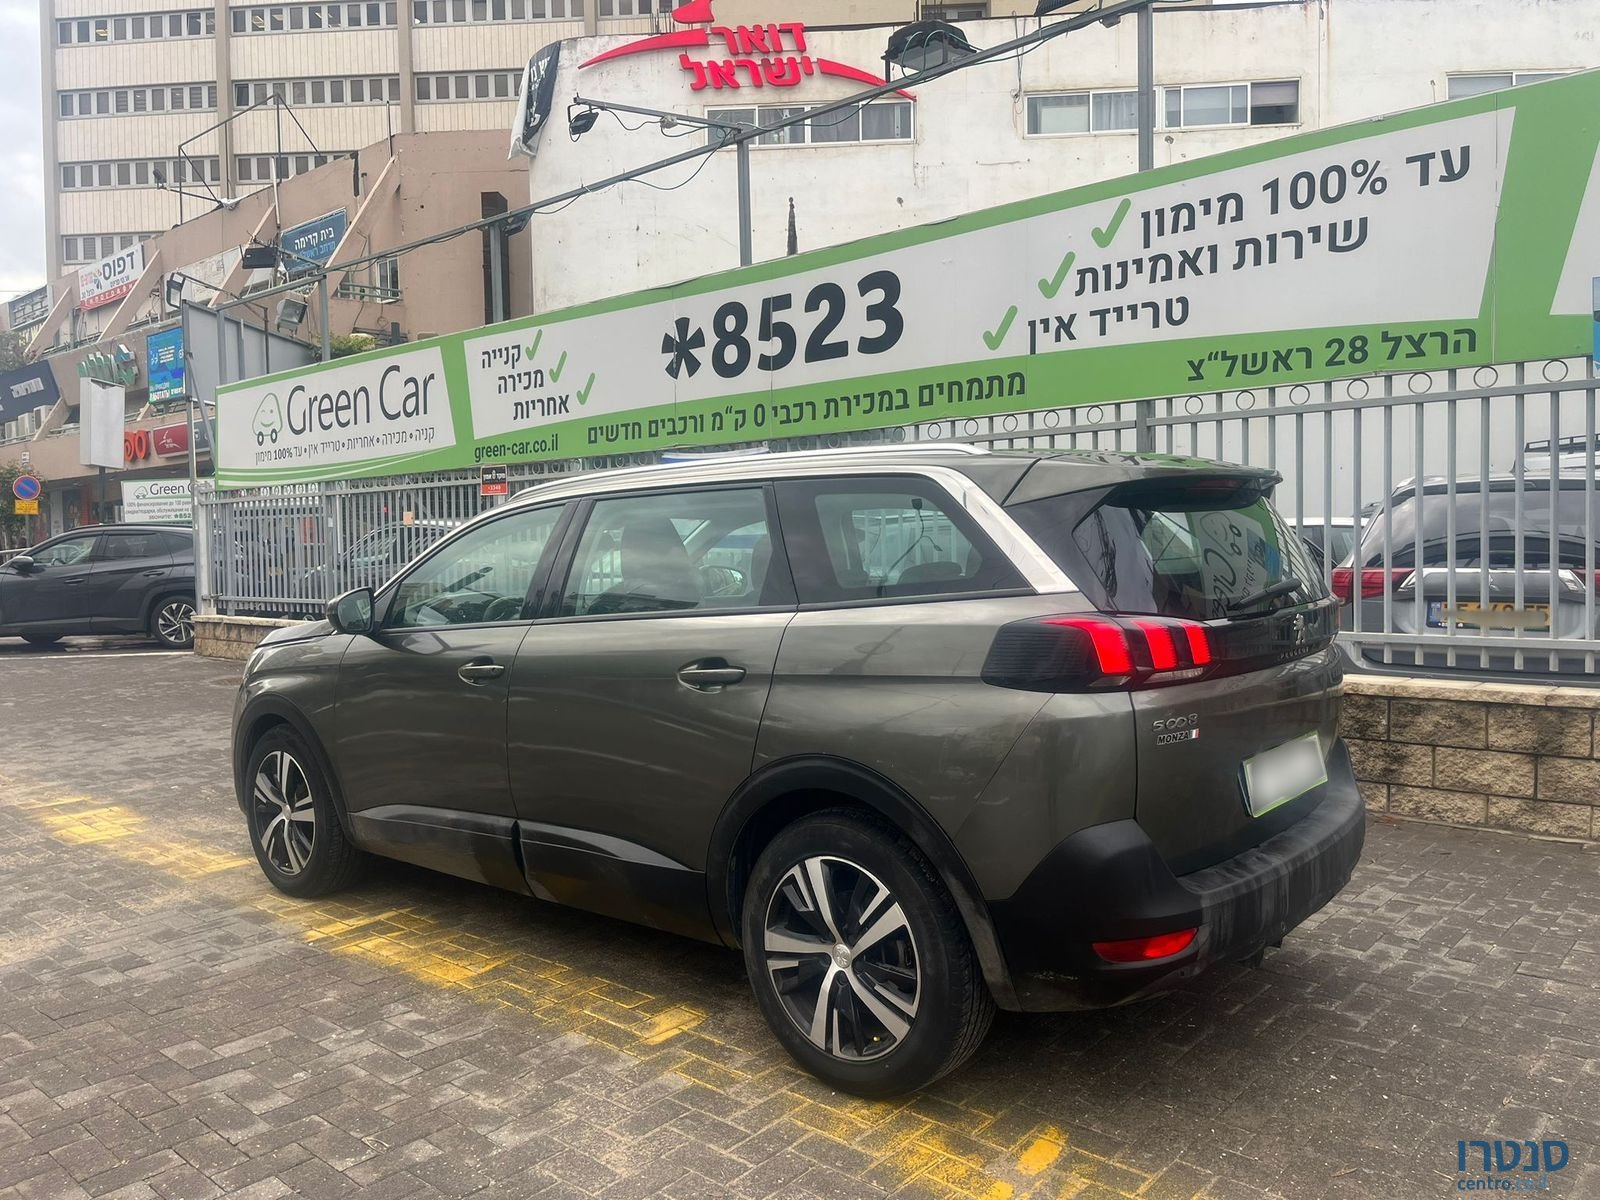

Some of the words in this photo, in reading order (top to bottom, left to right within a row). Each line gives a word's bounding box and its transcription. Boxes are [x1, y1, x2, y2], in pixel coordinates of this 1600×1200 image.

[710, 22, 807, 55] דואר
[679, 54, 814, 90] ישראל
[1406, 145, 1471, 187] עד
[1262, 159, 1387, 215] 100%
[1141, 192, 1243, 248] מימון
[294, 232, 318, 251] קדימה
[320, 227, 334, 241] בית
[1233, 216, 1369, 271] שירות
[102, 251, 135, 281] דפוס
[1075, 245, 1218, 297] ואמינות
[1089, 295, 1189, 337] טרייד
[1027, 313, 1077, 355] אין
[1381, 327, 1476, 361] הרצל
[482, 344, 521, 369] קנייה
[1325, 335, 1368, 368] 28
[498, 369, 544, 394] מכירה
[918, 371, 1026, 406] מתמחים
[287, 385, 370, 436] Green
[379, 365, 435, 421] Car
[513, 394, 570, 420] אחריות
[772, 399, 817, 425] רכבי
[824, 391, 909, 419] במכירת
[648, 415, 705, 438] ורכבים
[753, 403, 766, 427] 0
[320, 439, 340, 453] טרייד
[346, 435, 375, 450] אחריות
[382, 430, 407, 446] מכירה
[415, 427, 435, 445] קניה
[587, 422, 642, 445] חדשים
[255, 450, 272, 466] מימון
[274, 448, 293, 461] 100%
[293, 446, 303, 457] עד
[308, 443, 318, 459] אין
[474, 433, 559, 463] green-car.co.il
[149, 483, 185, 496] Green
[1153, 713, 1198, 731] 5008
[1156, 730, 1189, 745] MONZA
